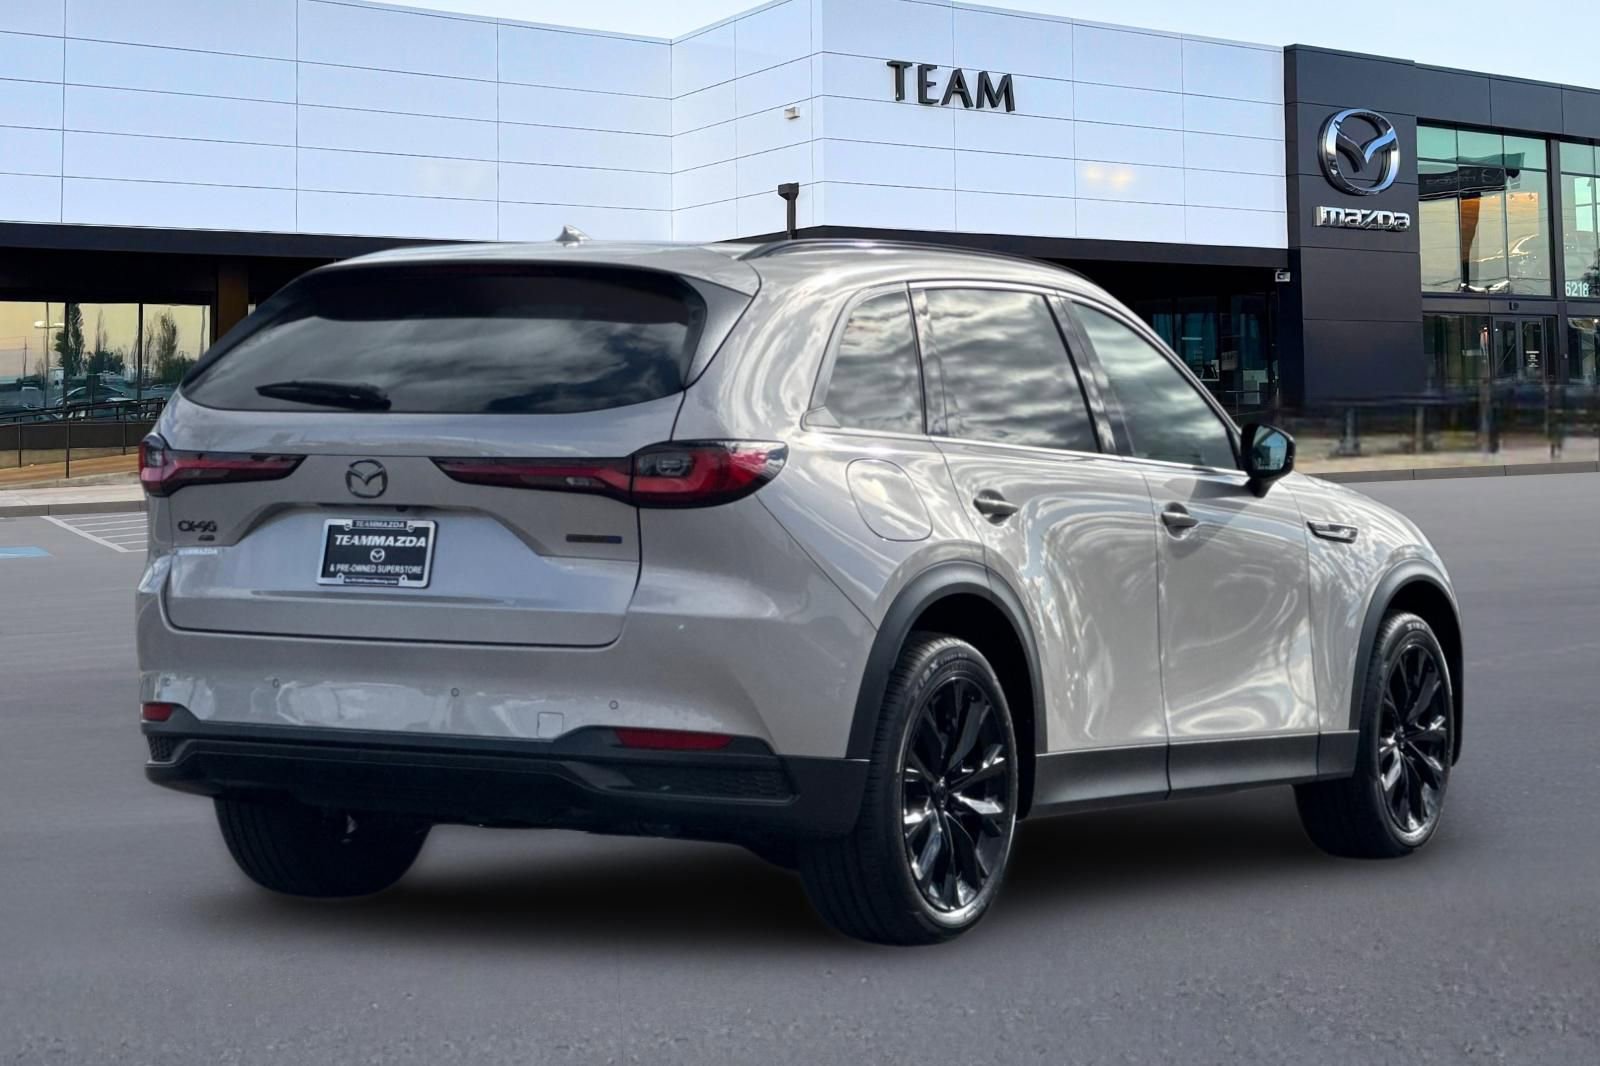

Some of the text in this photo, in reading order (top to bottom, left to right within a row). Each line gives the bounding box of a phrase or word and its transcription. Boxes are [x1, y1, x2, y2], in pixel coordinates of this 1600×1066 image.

[886, 60, 1016, 112] TEAM
[1565, 281, 1589, 297] 6218
[336, 564, 376, 573] PRE-OWNED
[377, 565, 423, 574] SUPERSTORE
